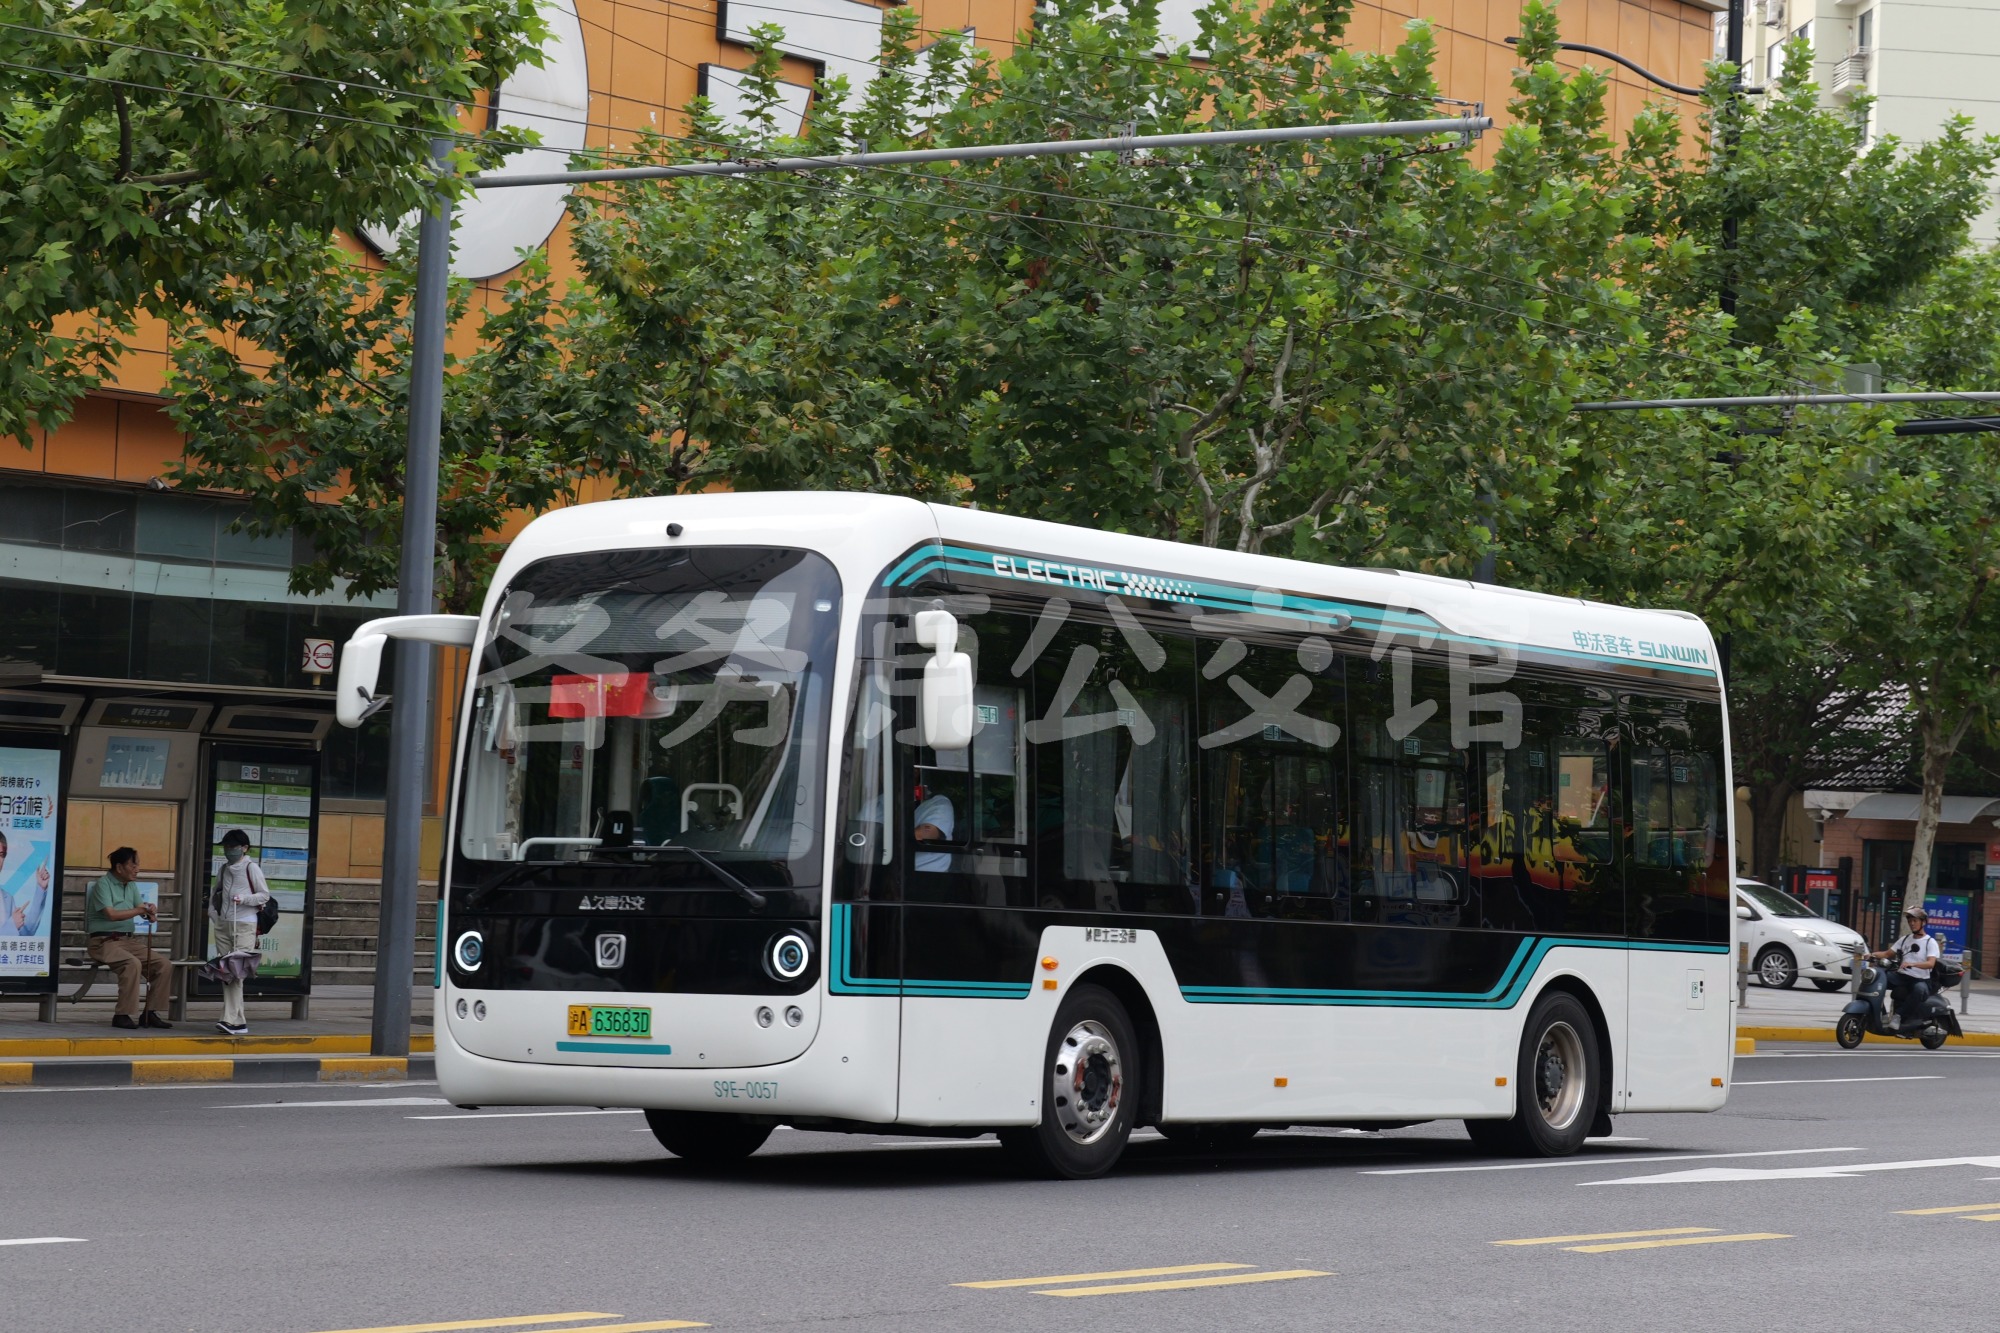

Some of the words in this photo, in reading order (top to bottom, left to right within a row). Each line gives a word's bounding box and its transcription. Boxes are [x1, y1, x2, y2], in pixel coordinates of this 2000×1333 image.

[992, 555, 1119, 592] ELECTRIC
[1572, 630, 1635, 656] 申沃客车
[1638, 640, 1709, 665] SUNWIN
[13, 818, 42, 829] 正式发布
[0, 941, 45, 952] 高德扫街榜
[0, 954, 45, 965] 金、打车红包
[595, 1010, 650, 1033] 63683D
[713, 1080, 778, 1099] S9E-0057
